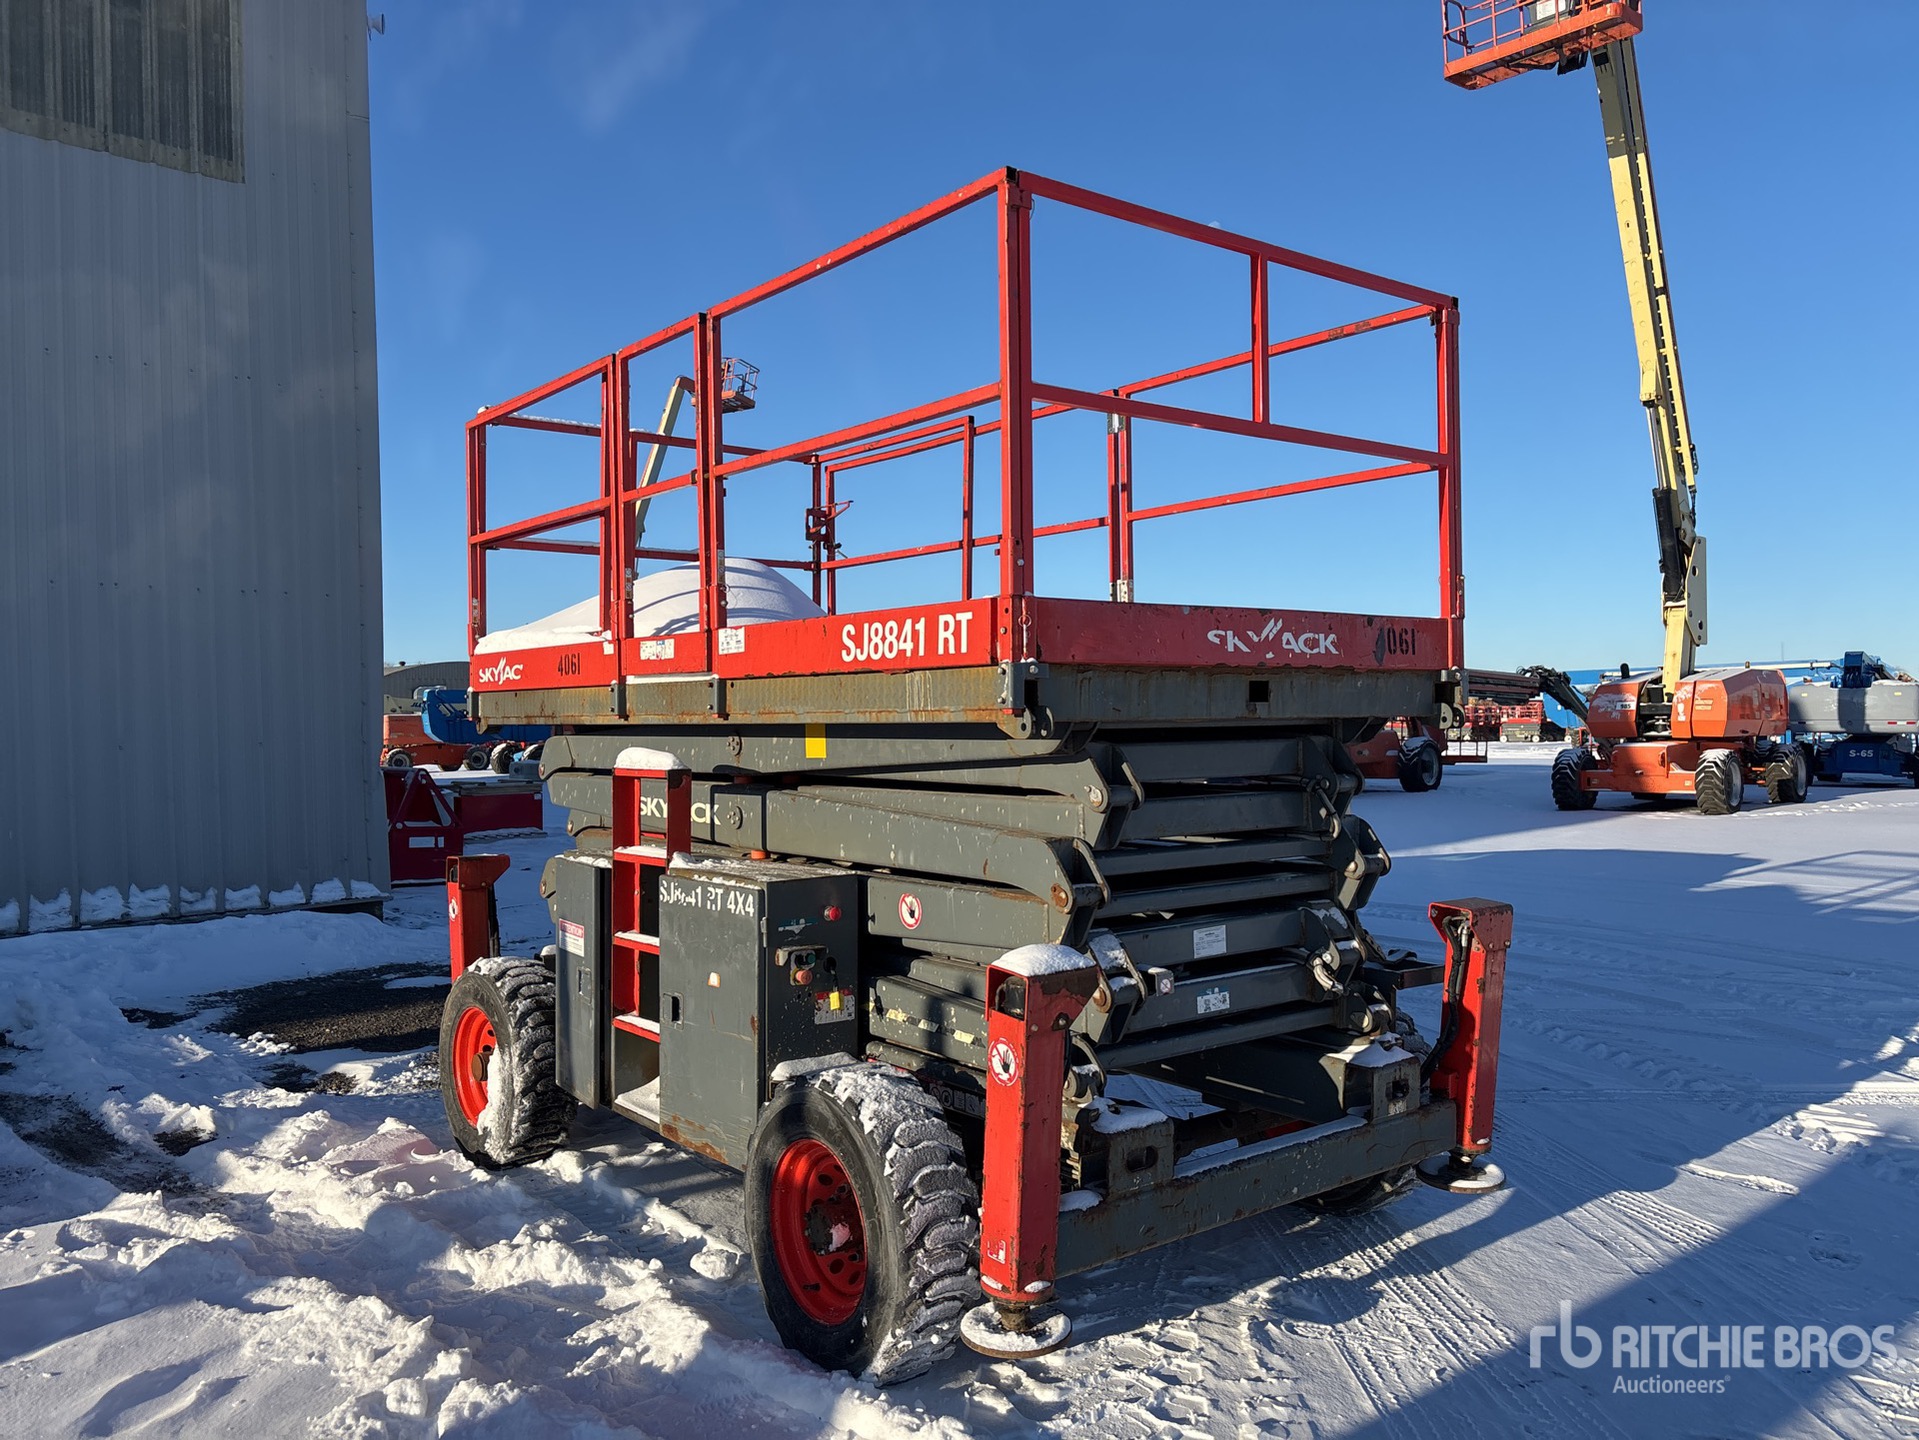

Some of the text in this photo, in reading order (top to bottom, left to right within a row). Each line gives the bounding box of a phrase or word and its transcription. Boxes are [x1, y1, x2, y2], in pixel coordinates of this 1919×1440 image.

[841, 611, 973, 662] SJ8841 RT
[1374, 627, 1416, 656] 061
[479, 657, 523, 685] SKYJAC
[558, 653, 581, 676] 4061
[1849, 749, 1874, 757] S-65
[640, 796, 721, 825] SKYCK
[727, 890, 755, 917] 4X4
